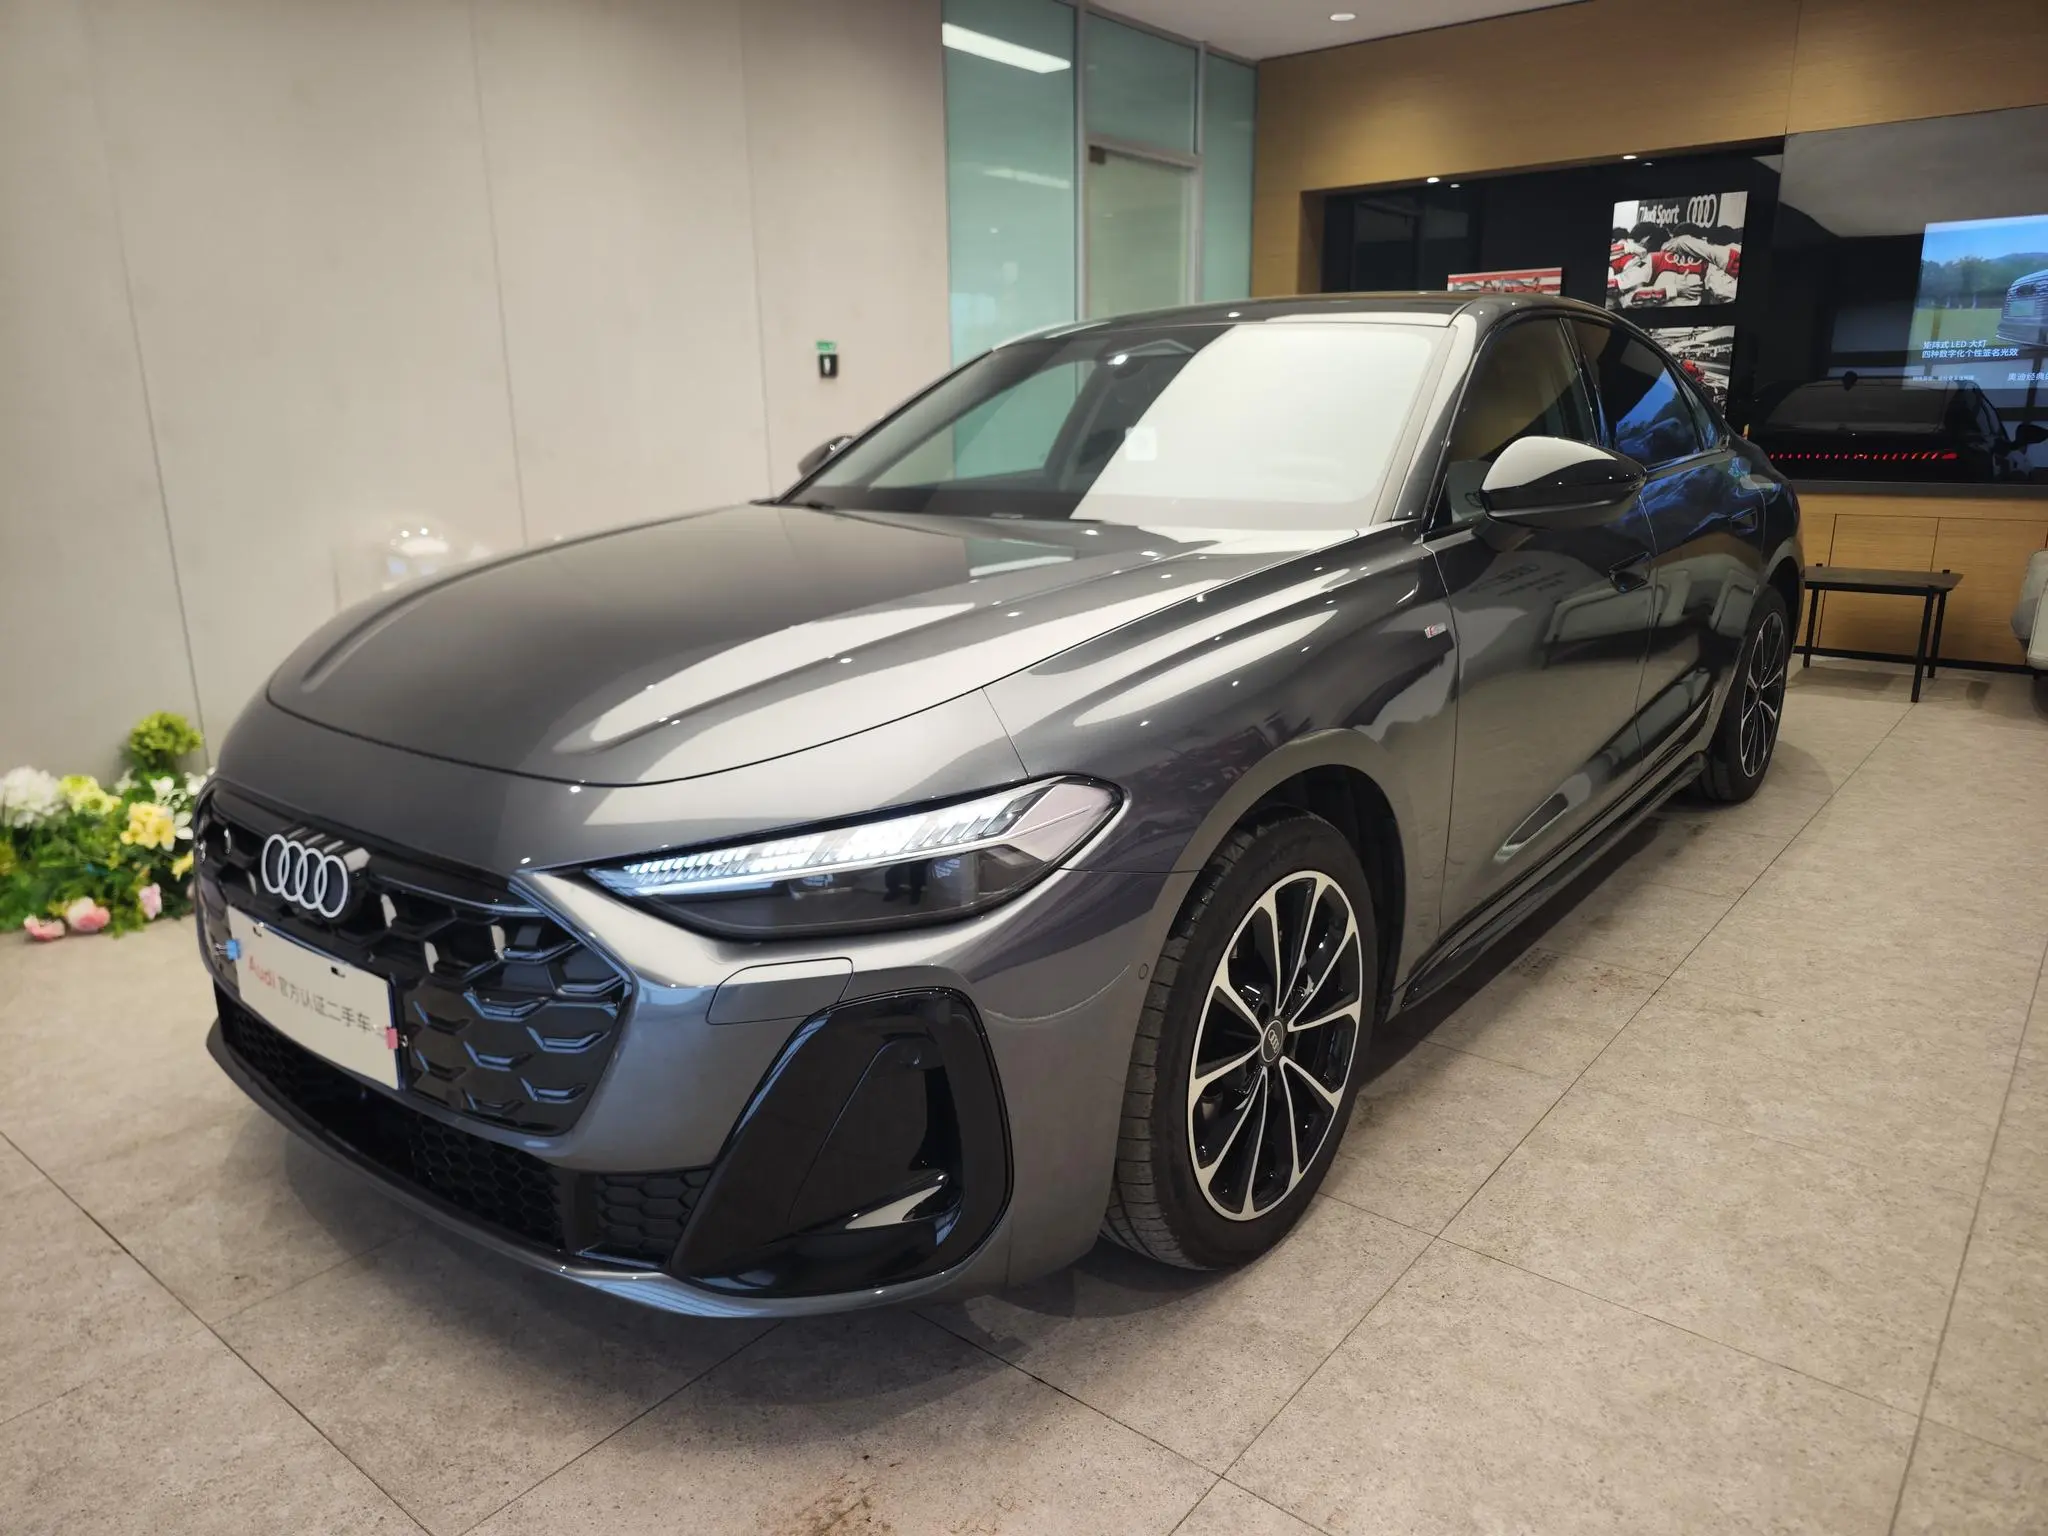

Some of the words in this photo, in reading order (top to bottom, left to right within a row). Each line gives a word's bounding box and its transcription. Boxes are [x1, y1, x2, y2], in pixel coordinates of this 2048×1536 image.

[1658, 204, 1680, 227] Sport
[1951, 340, 1967, 348] LED
[1969, 340, 1986, 348] 大灯
[248, 955, 277, 989] Audi
[278, 975, 371, 1033] 官方认证二手车
